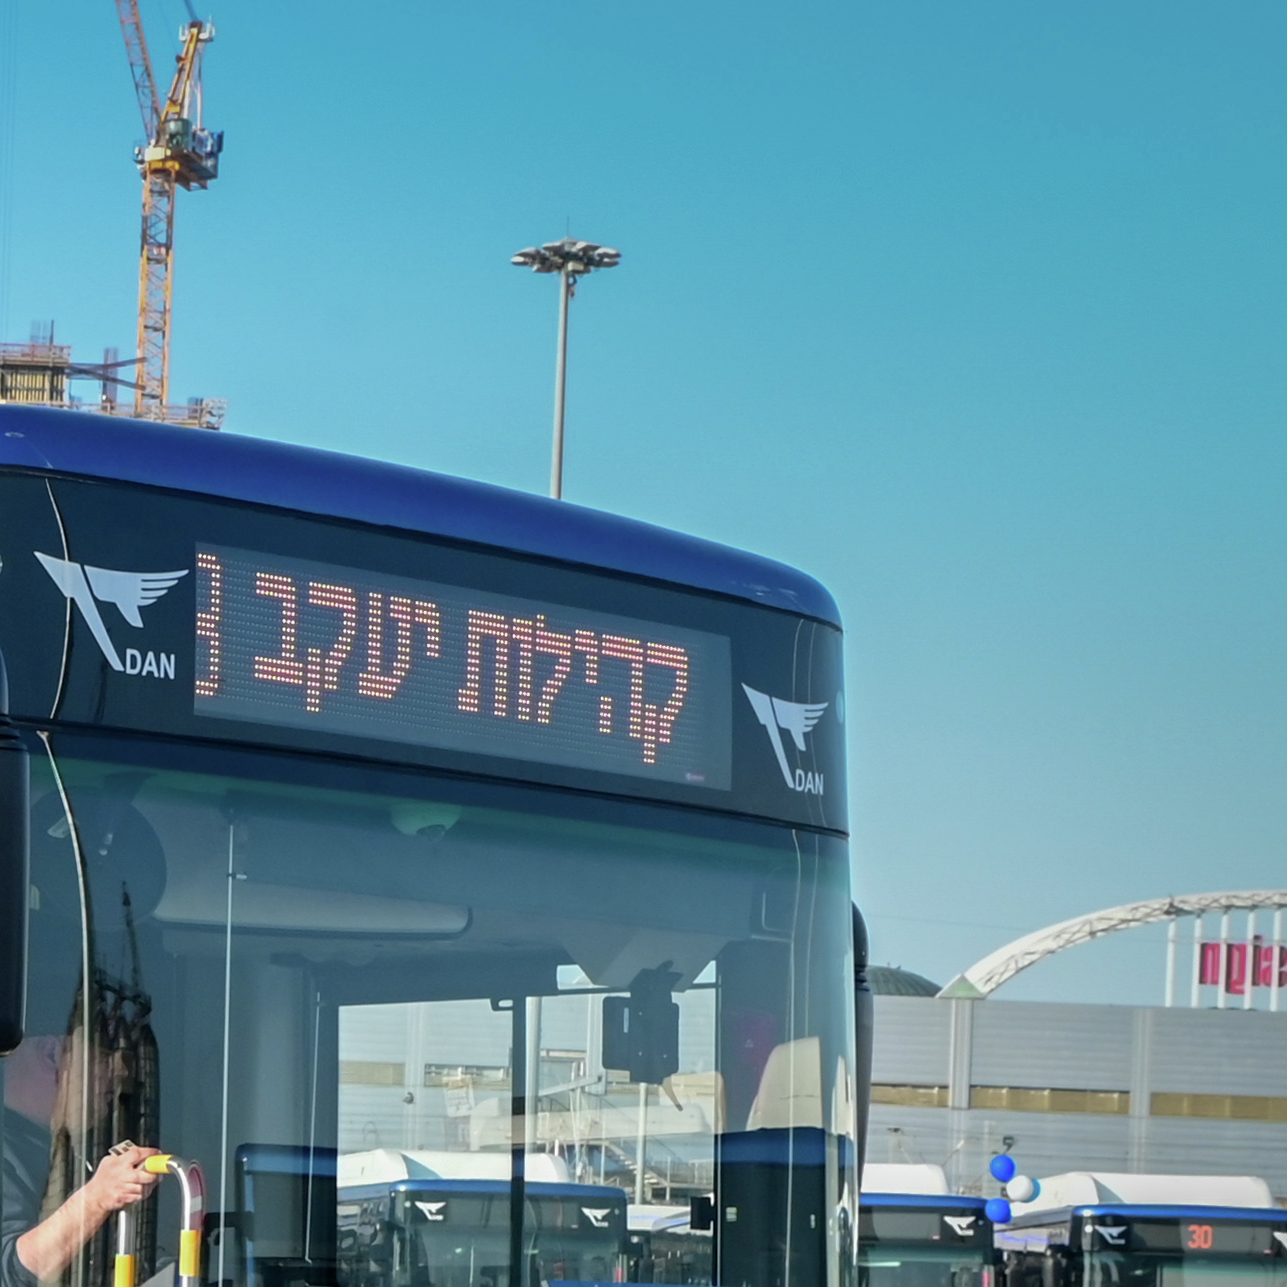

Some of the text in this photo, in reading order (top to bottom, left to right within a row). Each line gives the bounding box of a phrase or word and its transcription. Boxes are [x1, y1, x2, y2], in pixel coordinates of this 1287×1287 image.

[125, 641, 176, 680] DAN
[254, 571, 441, 713] יעקב
[457, 609, 689, 765] קהילות
[795, 768, 824, 796] DAN
[1188, 1224, 1214, 1249] 30
